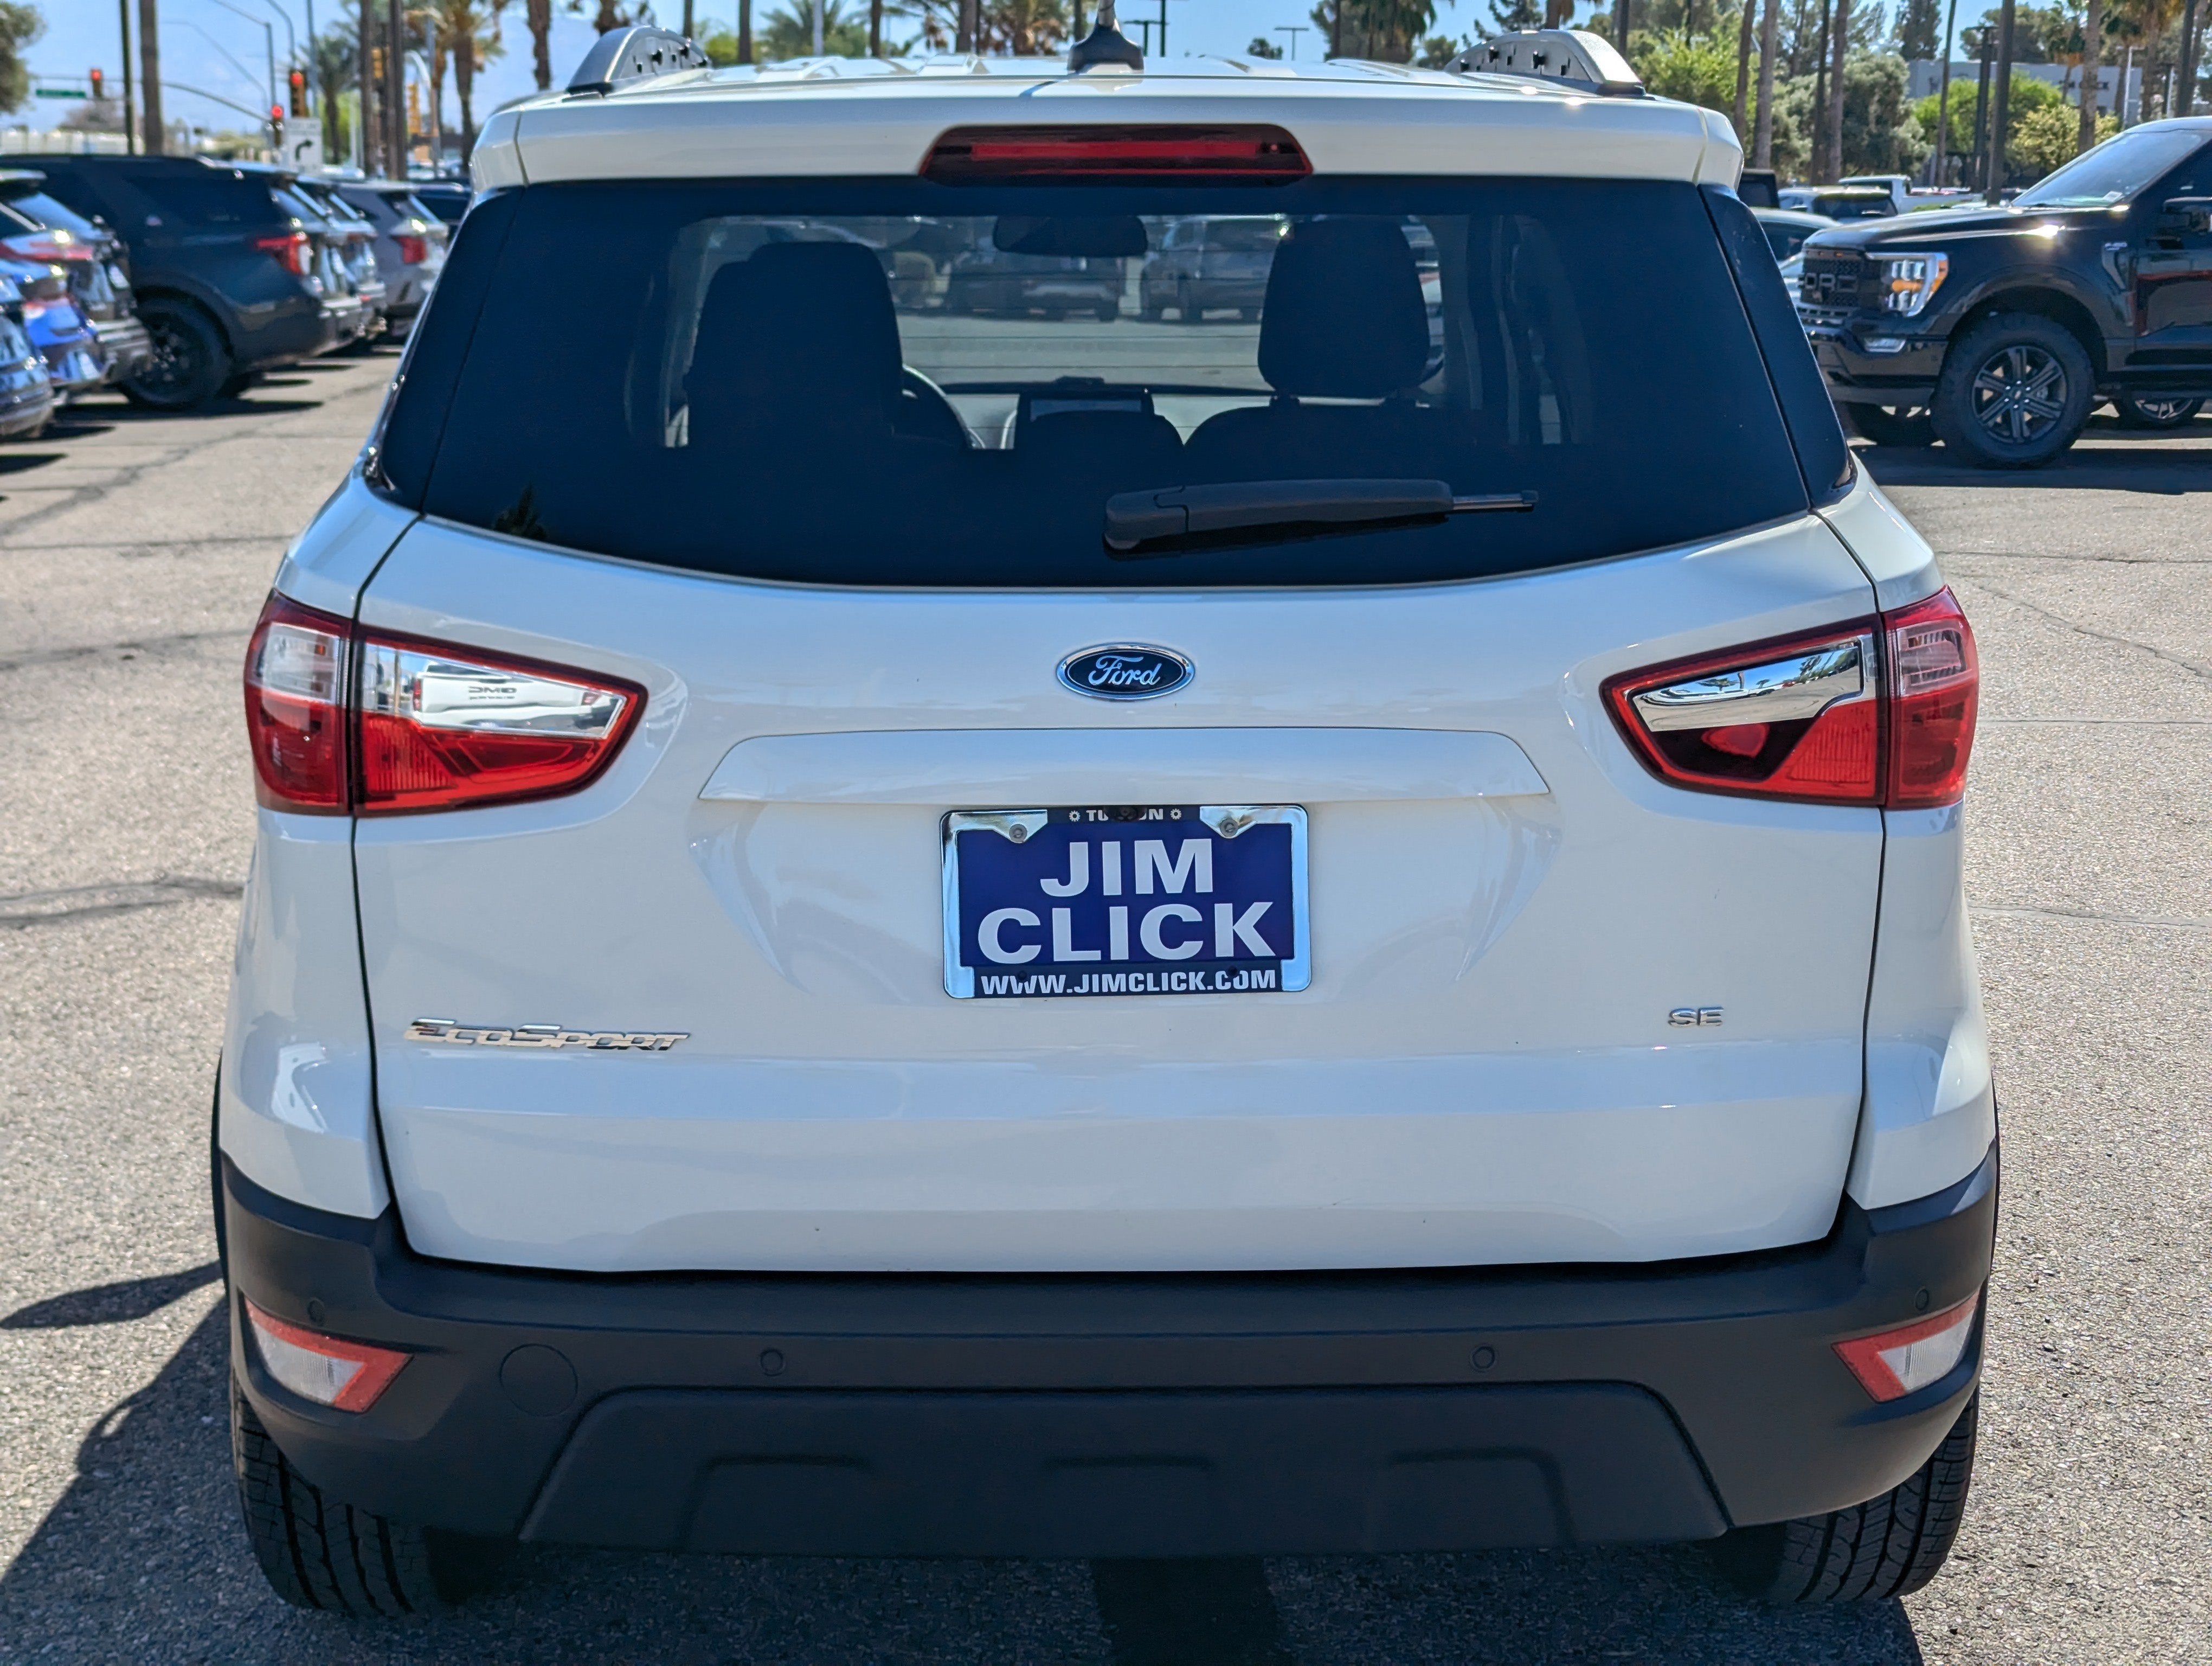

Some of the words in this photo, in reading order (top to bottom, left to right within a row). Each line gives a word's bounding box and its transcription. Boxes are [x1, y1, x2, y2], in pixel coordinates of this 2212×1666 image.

[1088, 655, 1162, 685] Ford
[1086, 809, 1163, 822] TUN
[1040, 838, 1213, 898] JIM
[978, 902, 1276, 964] CLICK
[981, 970, 1276, 995] WWW.JIMCLICK.COM
[1668, 1007, 1724, 1027] SE
